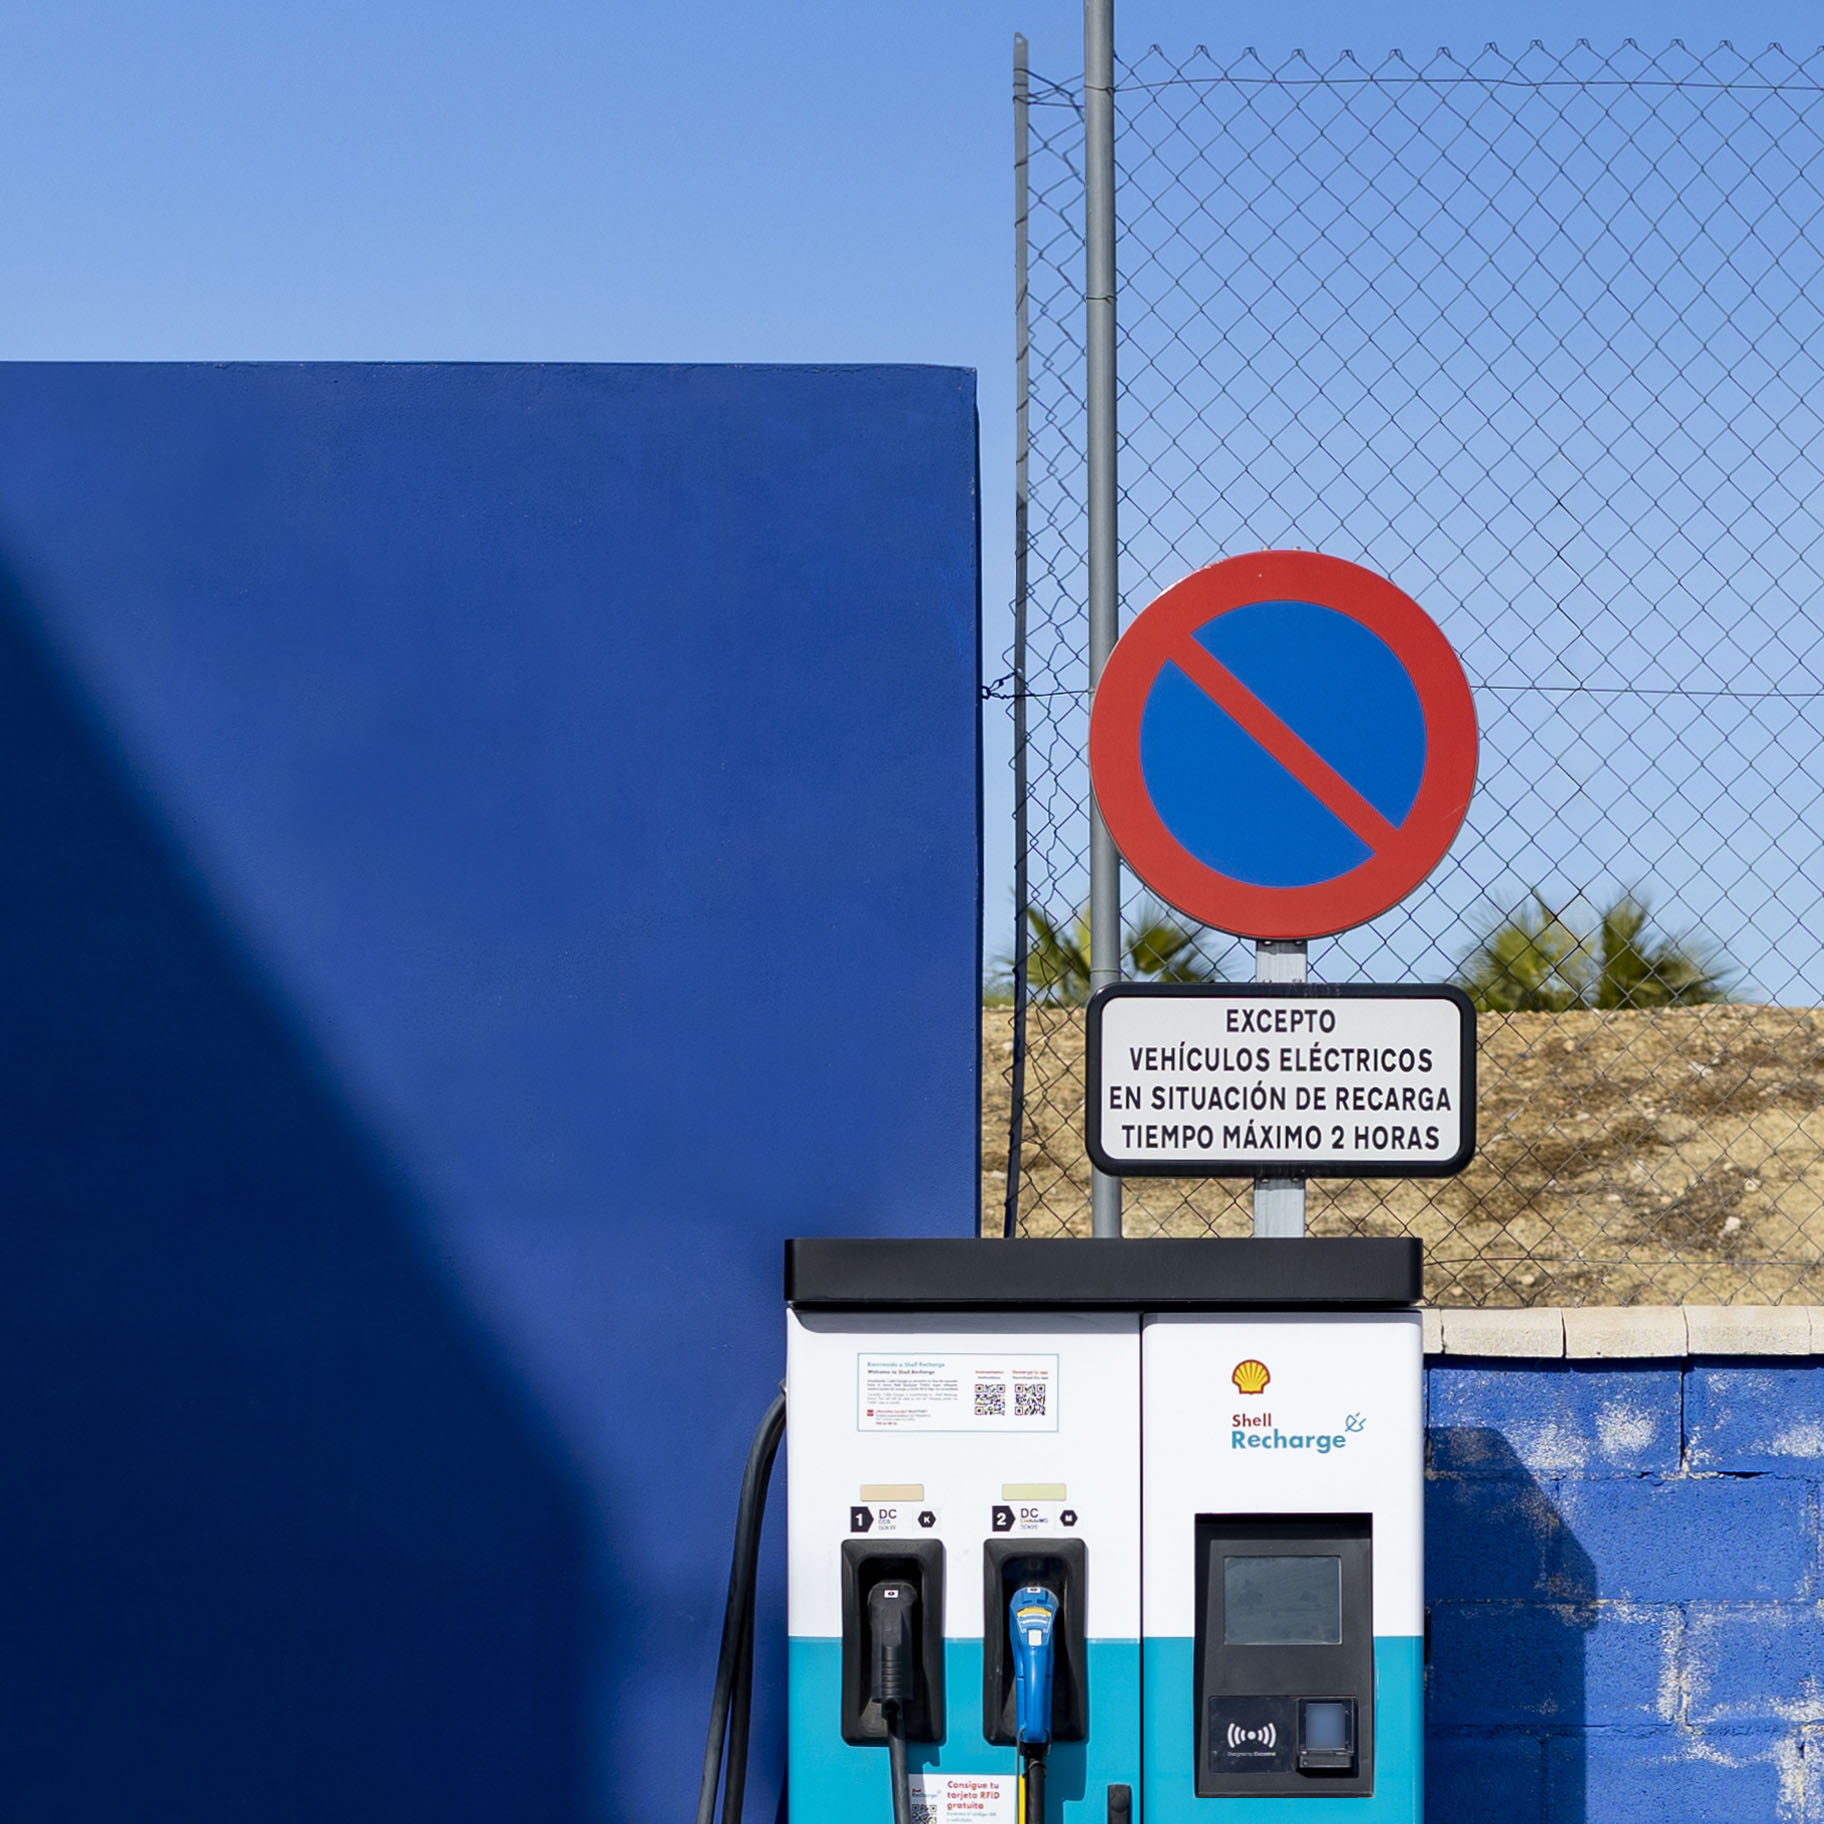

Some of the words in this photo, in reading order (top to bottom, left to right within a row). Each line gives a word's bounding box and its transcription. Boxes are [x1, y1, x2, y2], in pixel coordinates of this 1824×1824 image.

[1226, 1008, 1336, 1034] EXCEPTO
[1129, 1041, 1271, 1073] VEHÍCULOS
[1279, 1041, 1433, 1073] ELÉCTRICOS
[1109, 1085, 1141, 1110] EN
[1150, 1080, 1286, 1111] SITUACIÓN
[1295, 1086, 1327, 1111] DE
[1335, 1086, 1452, 1112] RECARGA
[1121, 1124, 1214, 1150] TIEMPO
[1223, 1118, 1322, 1150] MÁXIMO
[1331, 1124, 1345, 1150] 2
[1354, 1125, 1440, 1151] HORAS
[1232, 1413, 1272, 1428] Shell
[1231, 1428, 1347, 1454] Recharge
[855, 1513, 864, 1527] 1
[879, 1509, 897, 1519] DC
[923, 1516, 931, 1524] K
[996, 1512, 1007, 1526] 2
[1020, 1508, 1039, 1518] DC
[947, 1780, 988, 1791] Consigue
[990, 1781, 1000, 1790] tu
[947, 1791, 978, 1801] tarjeta
[980, 1791, 1001, 1800] RFID
[946, 1801, 984, 1811] gratuita
